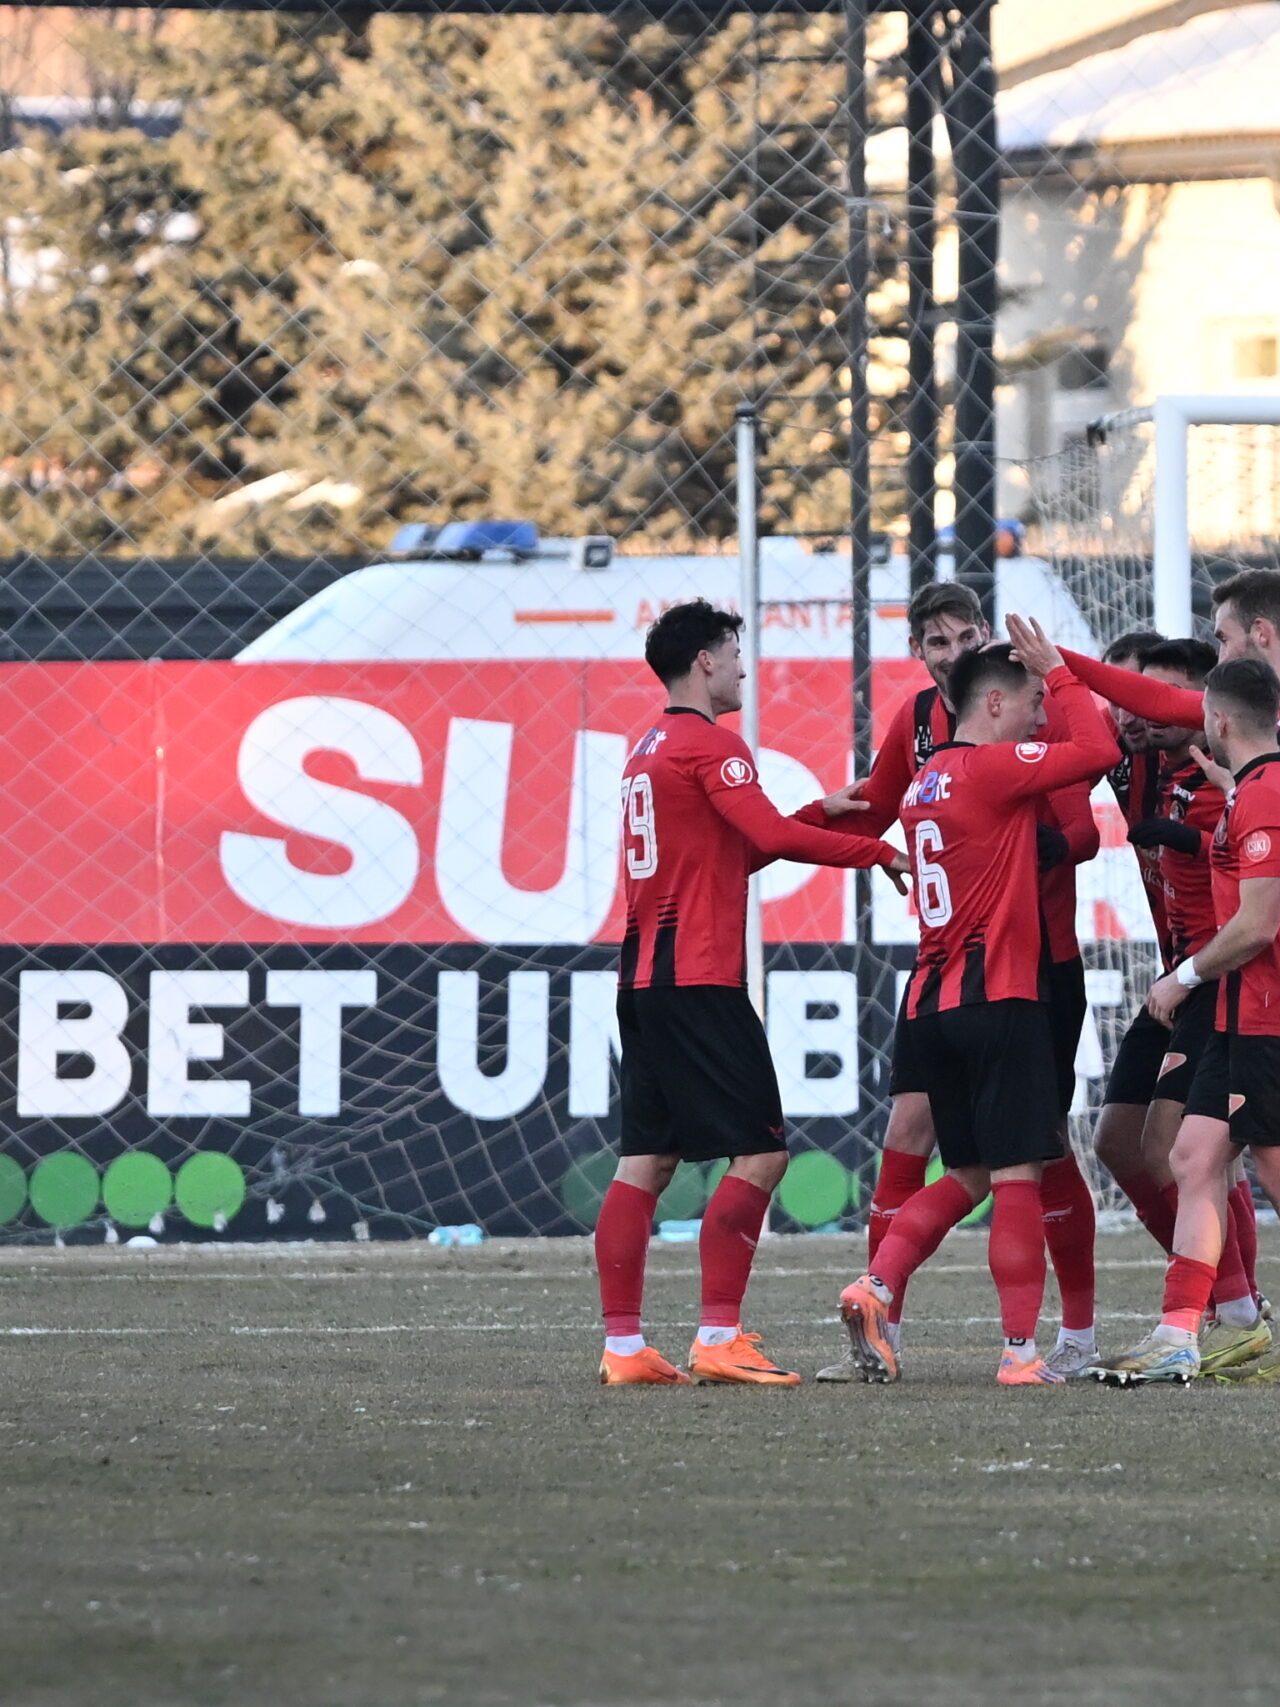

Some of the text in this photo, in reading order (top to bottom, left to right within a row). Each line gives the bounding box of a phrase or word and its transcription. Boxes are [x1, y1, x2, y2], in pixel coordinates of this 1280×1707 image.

[902, 771, 952, 808] MrBit
[916, 819, 953, 928] 6
[17, 969, 378, 1119] BET
